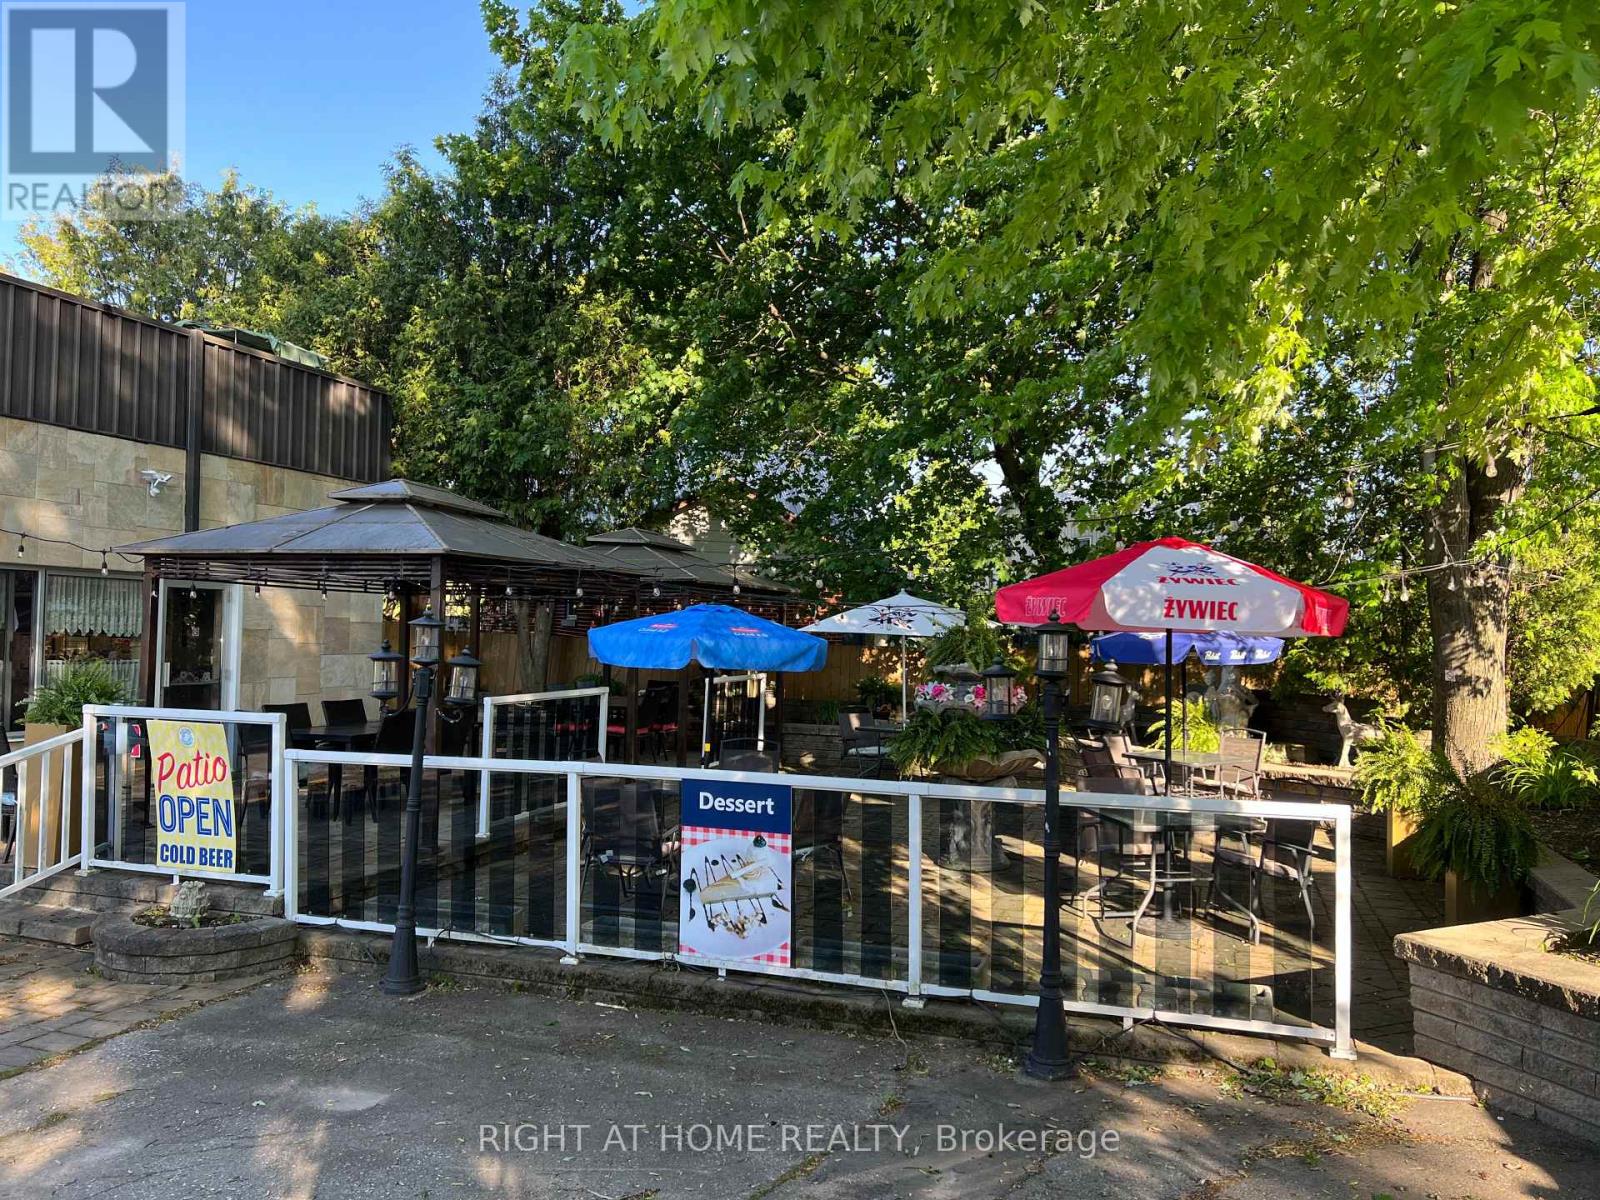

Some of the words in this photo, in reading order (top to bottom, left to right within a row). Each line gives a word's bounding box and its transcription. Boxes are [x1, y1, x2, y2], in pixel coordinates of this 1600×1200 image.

[1164, 596, 1239, 621] ŻYWIEC
[157, 750, 227, 793] Patio
[159, 794, 233, 838] OPEN
[699, 791, 775, 815] Dessert
[160, 843, 196, 865] COLD
[199, 848, 233, 869] BEER
